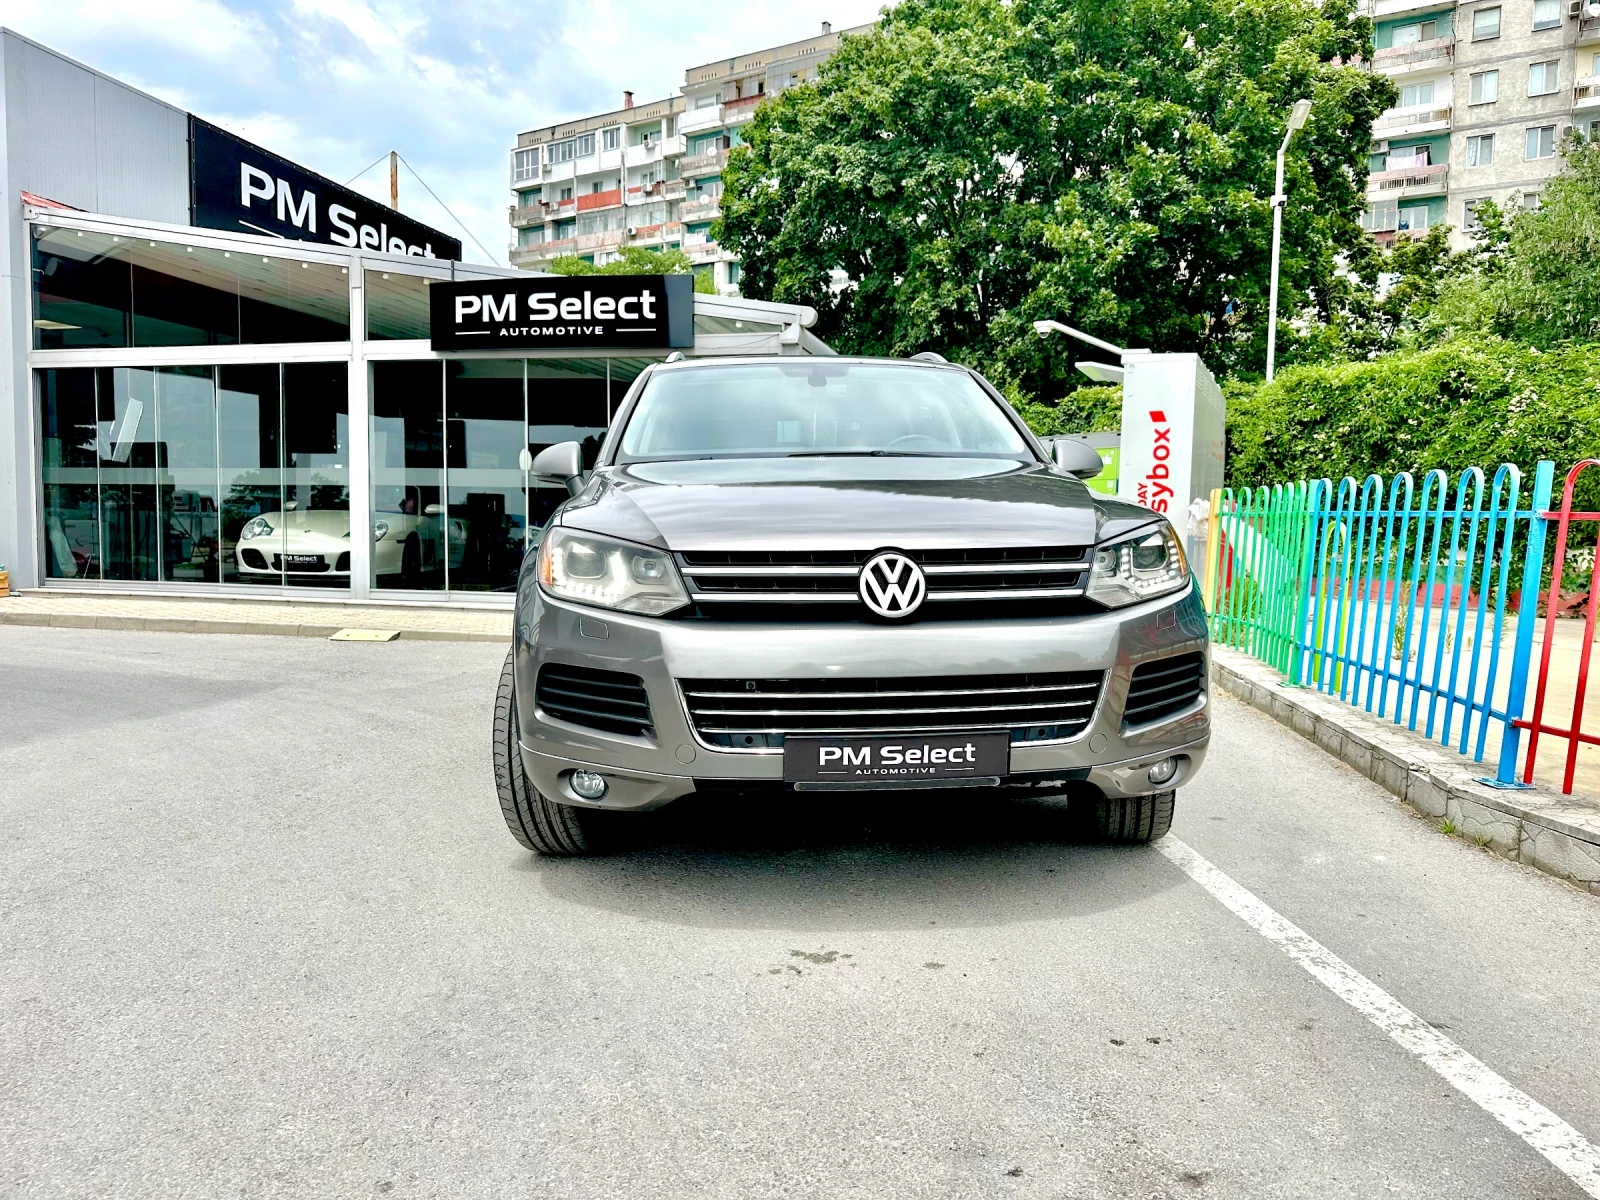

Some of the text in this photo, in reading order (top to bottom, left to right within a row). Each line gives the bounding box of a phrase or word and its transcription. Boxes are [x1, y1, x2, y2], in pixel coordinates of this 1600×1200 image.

[240, 161, 317, 234] PM
[455, 290, 656, 323] PM Select
[499, 326, 604, 337] AUTOMOTIVE
[862, 556, 922, 614] VW
[819, 742, 976, 766] PM Select
[855, 767, 936, 776] AUTOMOTIVE
